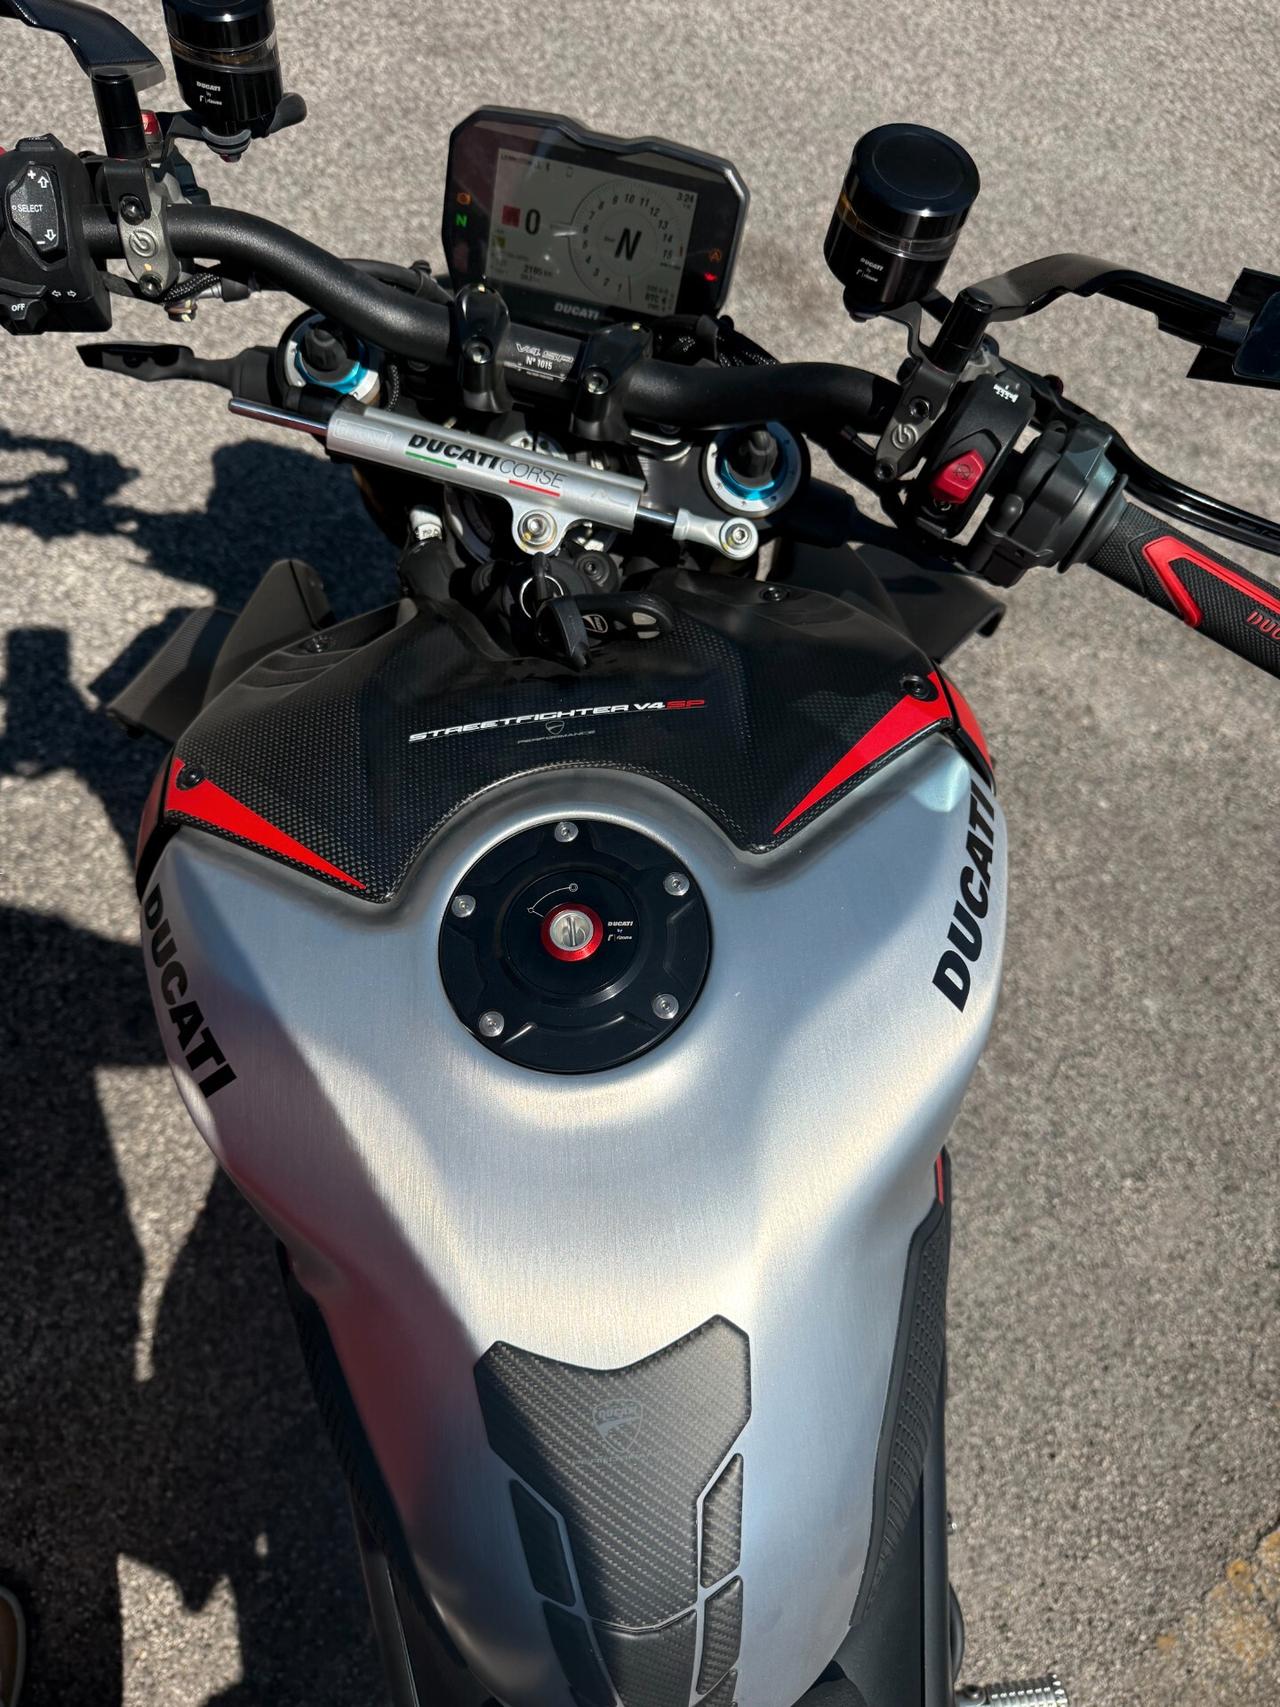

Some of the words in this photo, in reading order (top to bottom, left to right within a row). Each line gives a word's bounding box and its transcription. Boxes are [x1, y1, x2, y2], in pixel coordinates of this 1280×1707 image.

[196, 81, 221, 92] DUCATI
[625, 193, 635, 204] 10
[640, 198, 650, 207] 11
[17, 204, 43, 213] SELECT
[650, 207, 660, 217] 12
[456, 213, 468, 228] N
[525, 208, 541, 235] 0
[659, 220, 669, 230] 13
[614, 227, 642, 261] N
[663, 233, 673, 243] 14
[860, 257, 884, 271] DUCATI
[11, 303, 26, 312] OFF
[554, 302, 599, 320] DUCATI
[408, 434, 502, 470] DUCATI
[499, 458, 568, 488] CORSE
[409, 704, 630, 742] STREETFIGHTER
[932, 778, 995, 1014] DUCATI
[144, 883, 237, 1099] DUCATI
